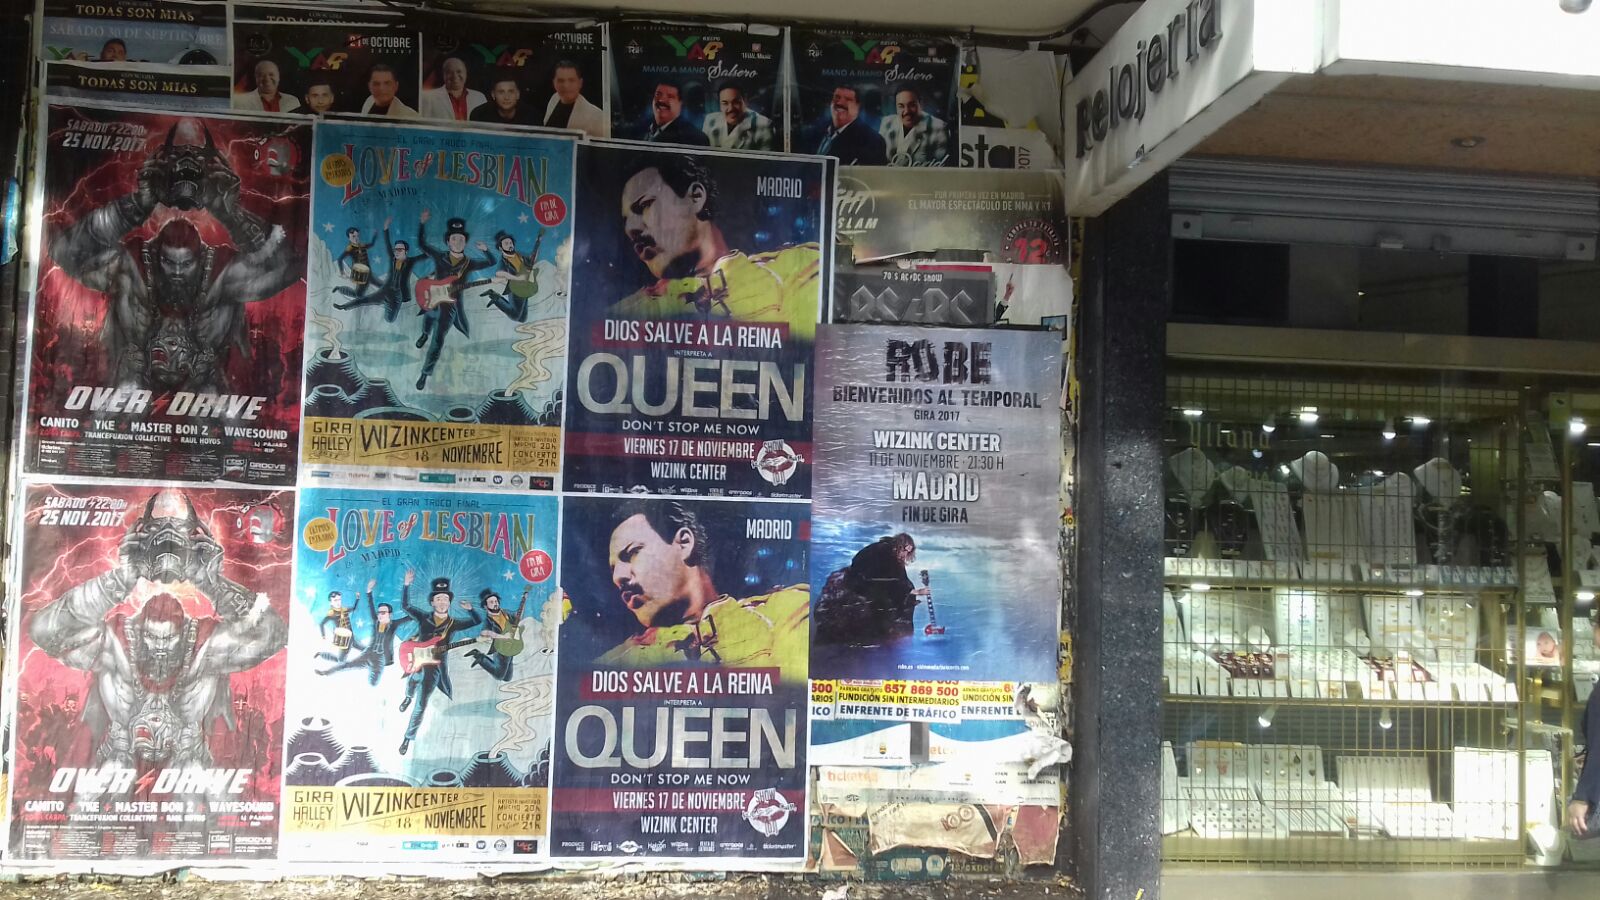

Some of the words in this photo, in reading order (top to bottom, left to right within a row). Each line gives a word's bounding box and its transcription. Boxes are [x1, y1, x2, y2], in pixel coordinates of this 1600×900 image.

[75, 5, 124, 18] TODAS
[131, 7, 156, 20] SON
[160, 9, 197, 22] MIAS
[370, 36, 412, 49] OCTUBRE
[554, 32, 595, 44] OCTUBRE
[642, 64, 670, 73] MANO
[671, 65, 679, 74] A
[679, 65, 706, 74] MANO
[707, 60, 759, 82] Salsero
[822, 67, 848, 78] MANO
[884, 64, 935, 84] Salsero
[79, 74, 127, 90] TODAS
[131, 78, 158, 92] SON
[162, 79, 198, 94] MIAS
[62, 132, 82, 148] 25
[960, 133, 1017, 169] sta
[340, 143, 411, 206] LOVE
[433, 149, 549, 208] LESBIAN
[756, 176, 803, 199] MADRID
[991, 191, 999, 200] EN
[908, 199, 918, 210] EL
[919, 200, 947, 211] MAYOR
[1002, 200, 1013, 211] DE
[837, 217, 879, 230] SLAM
[924, 274, 944, 285] SHOW
[603, 318, 641, 342] DIOS
[643, 321, 695, 345] SALVE
[697, 324, 710, 345] A
[714, 325, 734, 347] LA
[737, 327, 783, 349] REINA
[885, 338, 993, 386] ROBE
[576, 351, 806, 422] QUEEN
[63, 385, 154, 414] OVER
[165, 391, 268, 421] DRIVE
[831, 386, 934, 406] BIENVENIDOS
[937, 388, 958, 406] AL
[962, 389, 1043, 410] TEMPORAL
[913, 409, 936, 421] GIRA
[937, 410, 961, 422] 2017
[39, 416, 80, 430] CANITO
[94, 420, 117, 431] YKE
[130, 421, 173, 435] MASTER
[175, 424, 199, 436] BON
[200, 426, 210, 437] Z
[224, 426, 289, 441] WAVESOUND
[313, 421, 352, 435] GIRA
[621, 419, 665, 436] DON'T
[667, 422, 701, 437] STOP
[703, 423, 723, 438] ME
[726, 424, 761, 439] NOW
[134, 434, 173, 443] COLLECTIVE
[312, 436, 353, 452] HALLEY
[872, 430, 934, 449] WIZINK
[936, 432, 1001, 453] CENTER
[414, 450, 431, 463] 18
[441, 440, 504, 466] NOVIEMBRE
[512, 450, 557, 460] CONCIERTO
[623, 437, 668, 457] VIERNES
[668, 440, 680, 457] 17
[681, 441, 695, 458] DE
[696, 441, 756, 460] NOVIEMBRE
[868, 452, 878, 467] 11
[878, 453, 895, 468] DE
[896, 454, 960, 470] NOVIEMBRE
[967, 456, 994, 471] 21:30
[996, 458, 1005, 471] H
[650, 461, 688, 480] WIZINK
[689, 463, 728, 481] CENTER
[892, 471, 981, 502] MADRID
[381, 497, 392, 506] EL
[396, 498, 420, 507] GRAN
[457, 499, 481, 509] FINAL
[39, 509, 60, 526] 25
[901, 506, 922, 524] FIN
[923, 506, 937, 524] DE
[940, 507, 969, 525] GIRA
[324, 507, 395, 570] LOVE
[397, 513, 418, 540] of
[420, 510, 536, 565] LESBIAN
[745, 519, 793, 541] MADRID
[591, 670, 629, 693] DIOS
[631, 671, 684, 695] SALVE
[686, 672, 701, 695] A
[703, 672, 724, 695] LA
[726, 672, 774, 696] REINA
[811, 683, 833, 694] 500
[883, 683, 906, 695] 657
[910, 684, 934, 696] 869
[936, 686, 960, 697] 500
[881, 694, 896, 704] SIN
[896, 695, 960, 706] INTERMEDIARIOS
[811, 705, 831, 717] ICO
[840, 704, 894, 717] ENFRENTE
[896, 706, 910, 718] DE
[911, 706, 957, 720] TRÁFICO
[961, 705, 1014, 717] ENFRENTE
[564, 704, 798, 769] QUEEN
[48, 767, 138, 793] OVER
[610, 773, 655, 786] DON'T
[657, 773, 691, 786] STOP
[693, 774, 713, 786] ME
[717, 774, 752, 786] NOW
[24, 799, 66, 813] CANITO
[114, 801, 158, 814] MASTER
[208, 801, 275, 813] WAVESOUND
[293, 791, 335, 804] GIRA
[612, 790, 656, 810] VIERNES
[658, 792, 670, 810] 17
[672, 792, 686, 810] DE
[687, 792, 747, 811] NOVIEMBRE
[292, 805, 334, 821] HALLEY
[397, 817, 412, 829] 18
[424, 804, 488, 830] NOVIEMBRE
[496, 812, 542, 821] CONCIERTO
[640, 816, 678, 835] WIZINK
[680, 816, 719, 835] CENTER
